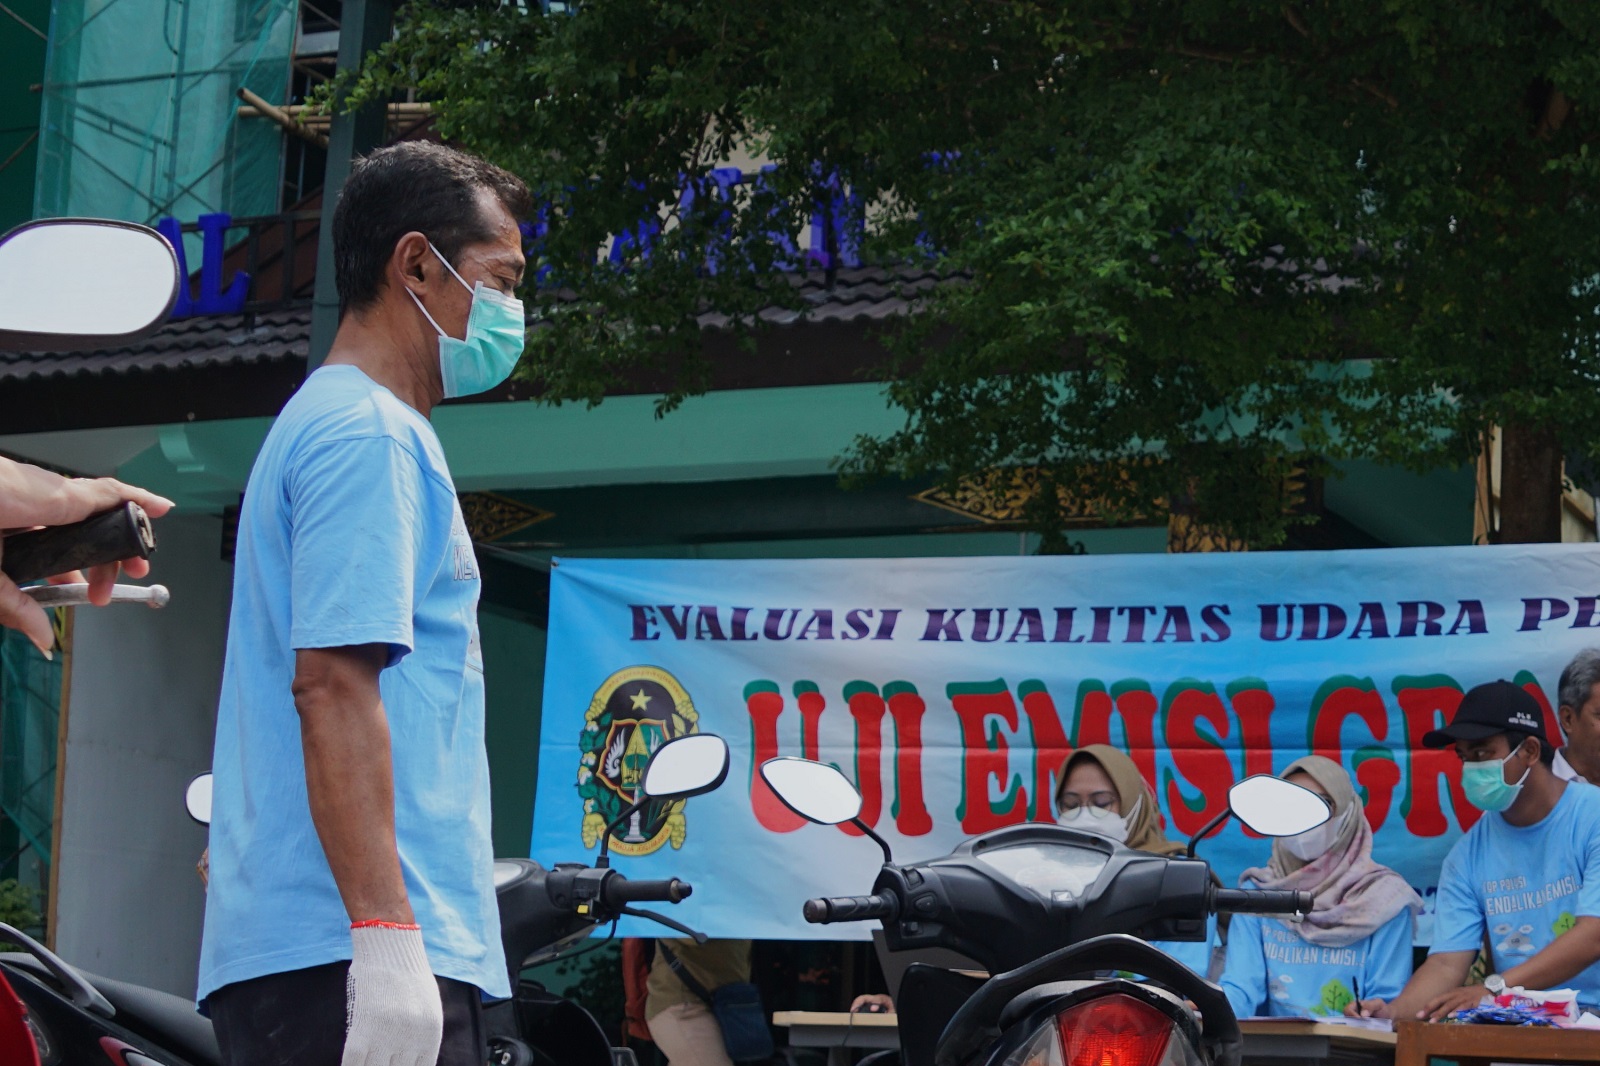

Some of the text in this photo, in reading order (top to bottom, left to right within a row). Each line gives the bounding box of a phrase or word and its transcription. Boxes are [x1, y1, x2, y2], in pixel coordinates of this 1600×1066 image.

[627, 603, 903, 642] EVALUASI
[919, 603, 1233, 644] KUALITAS
[1256, 599, 1490, 643] UDARA
[743, 678, 933, 838] UJI
[945, 676, 1276, 839] EMISI
[1485, 886, 1546, 916] ENDALIKAN
